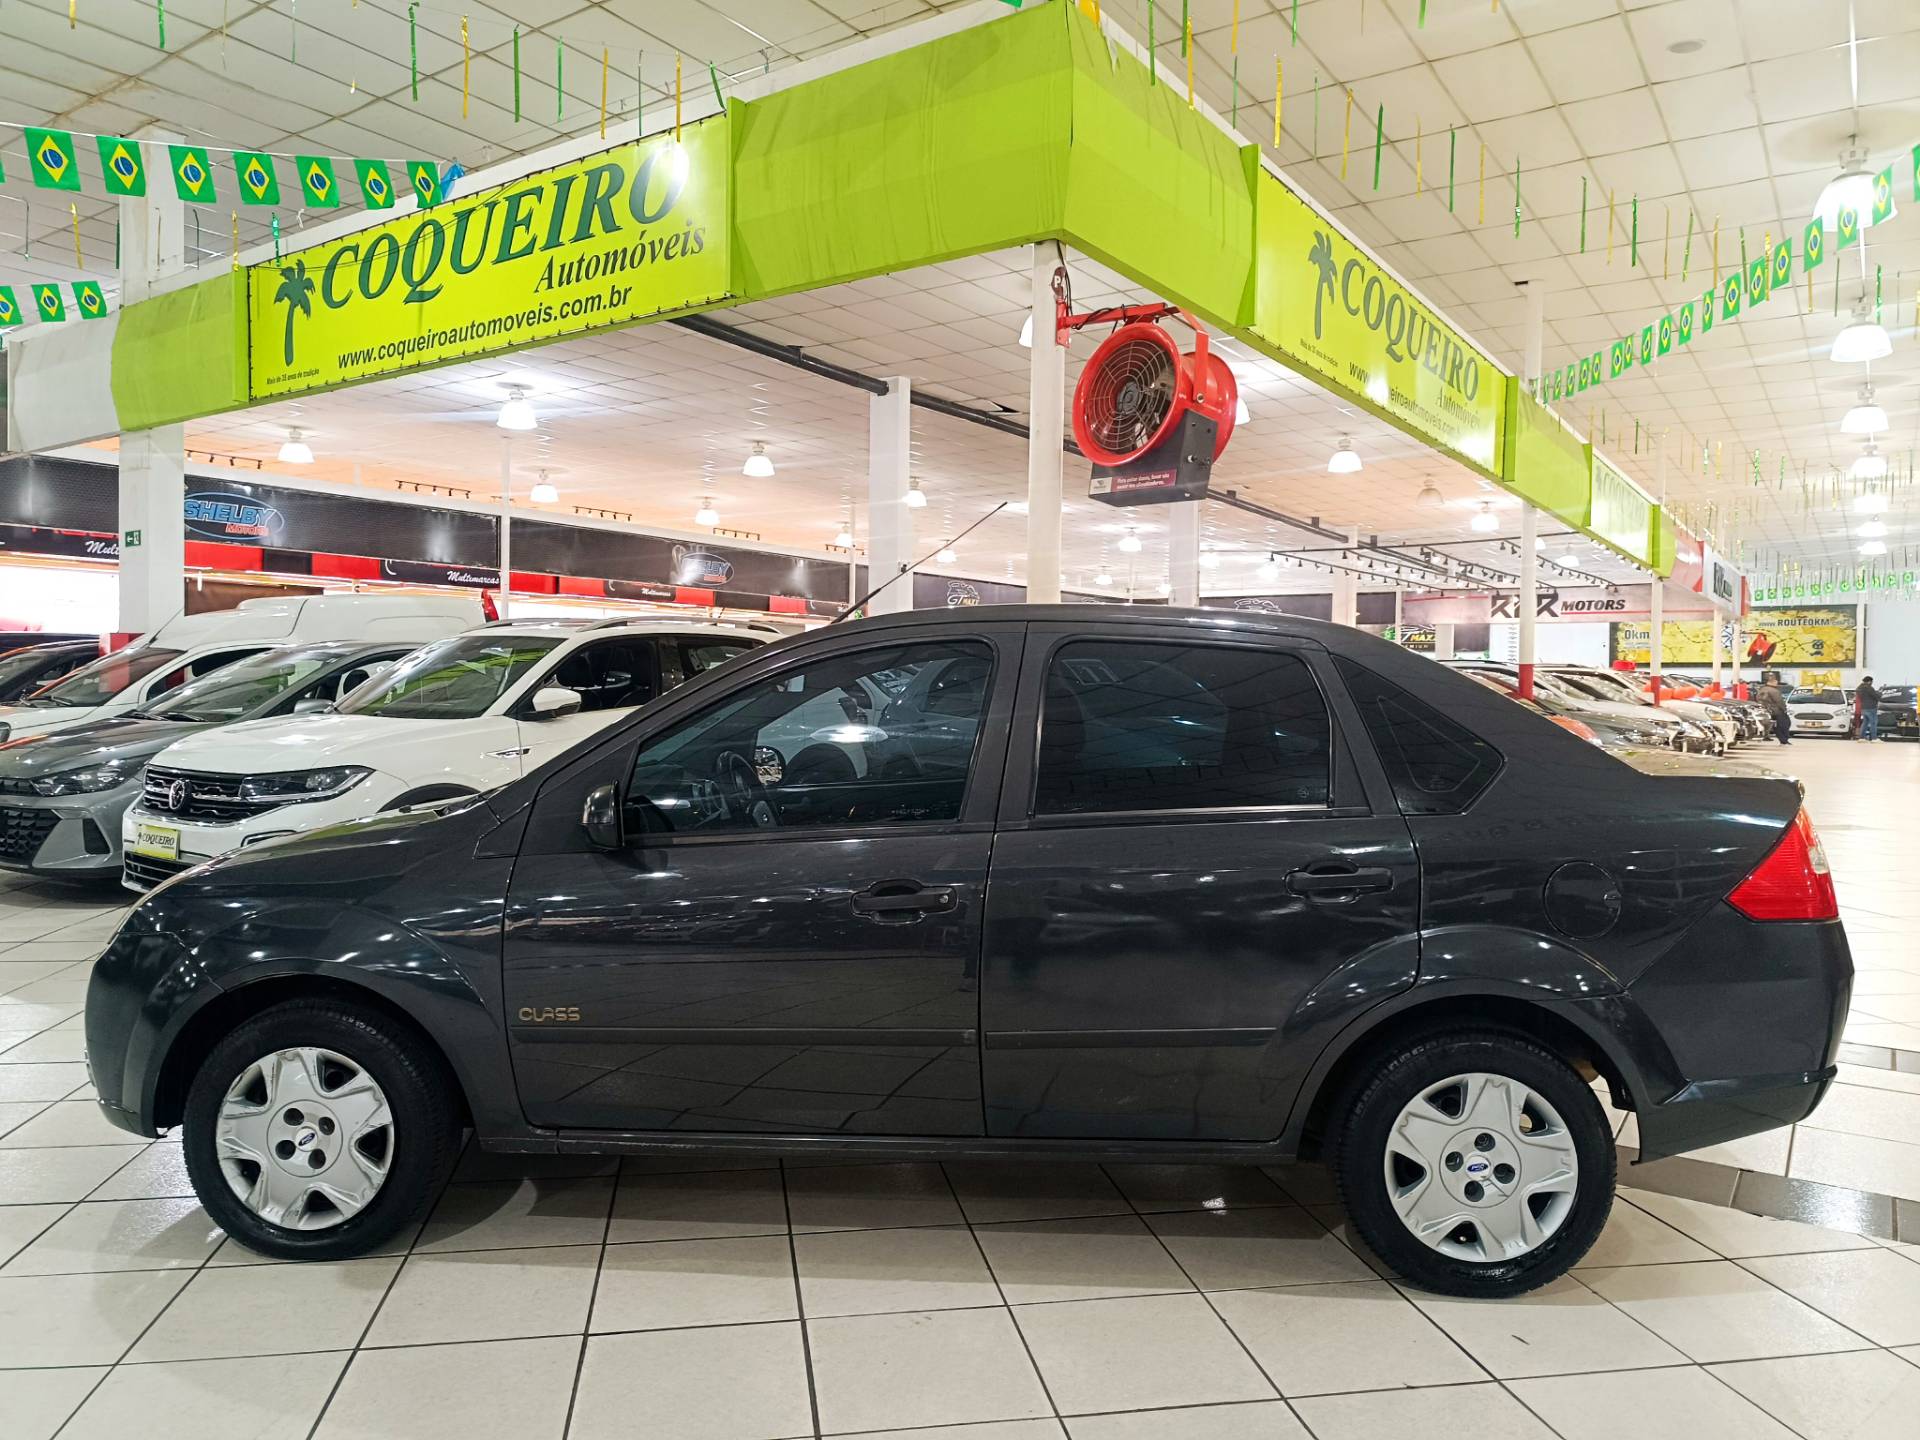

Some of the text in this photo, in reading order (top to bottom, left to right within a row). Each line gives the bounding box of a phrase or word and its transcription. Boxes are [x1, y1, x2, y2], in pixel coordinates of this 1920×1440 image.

[321, 143, 689, 309] COQUEIRO
[533, 220, 705, 293] Automóveis
[338, 284, 633, 369] www.coqueiroautomoveis.com.br
[1342, 258, 1479, 401] COQUEIRO
[184, 499, 276, 526] SHELBY
[446, 570, 500, 585] Multimarcas
[1561, 599, 1626, 612] MOTORS
[143, 832, 175, 846] COQUEIRO
[518, 1006, 581, 1022] CLASS
